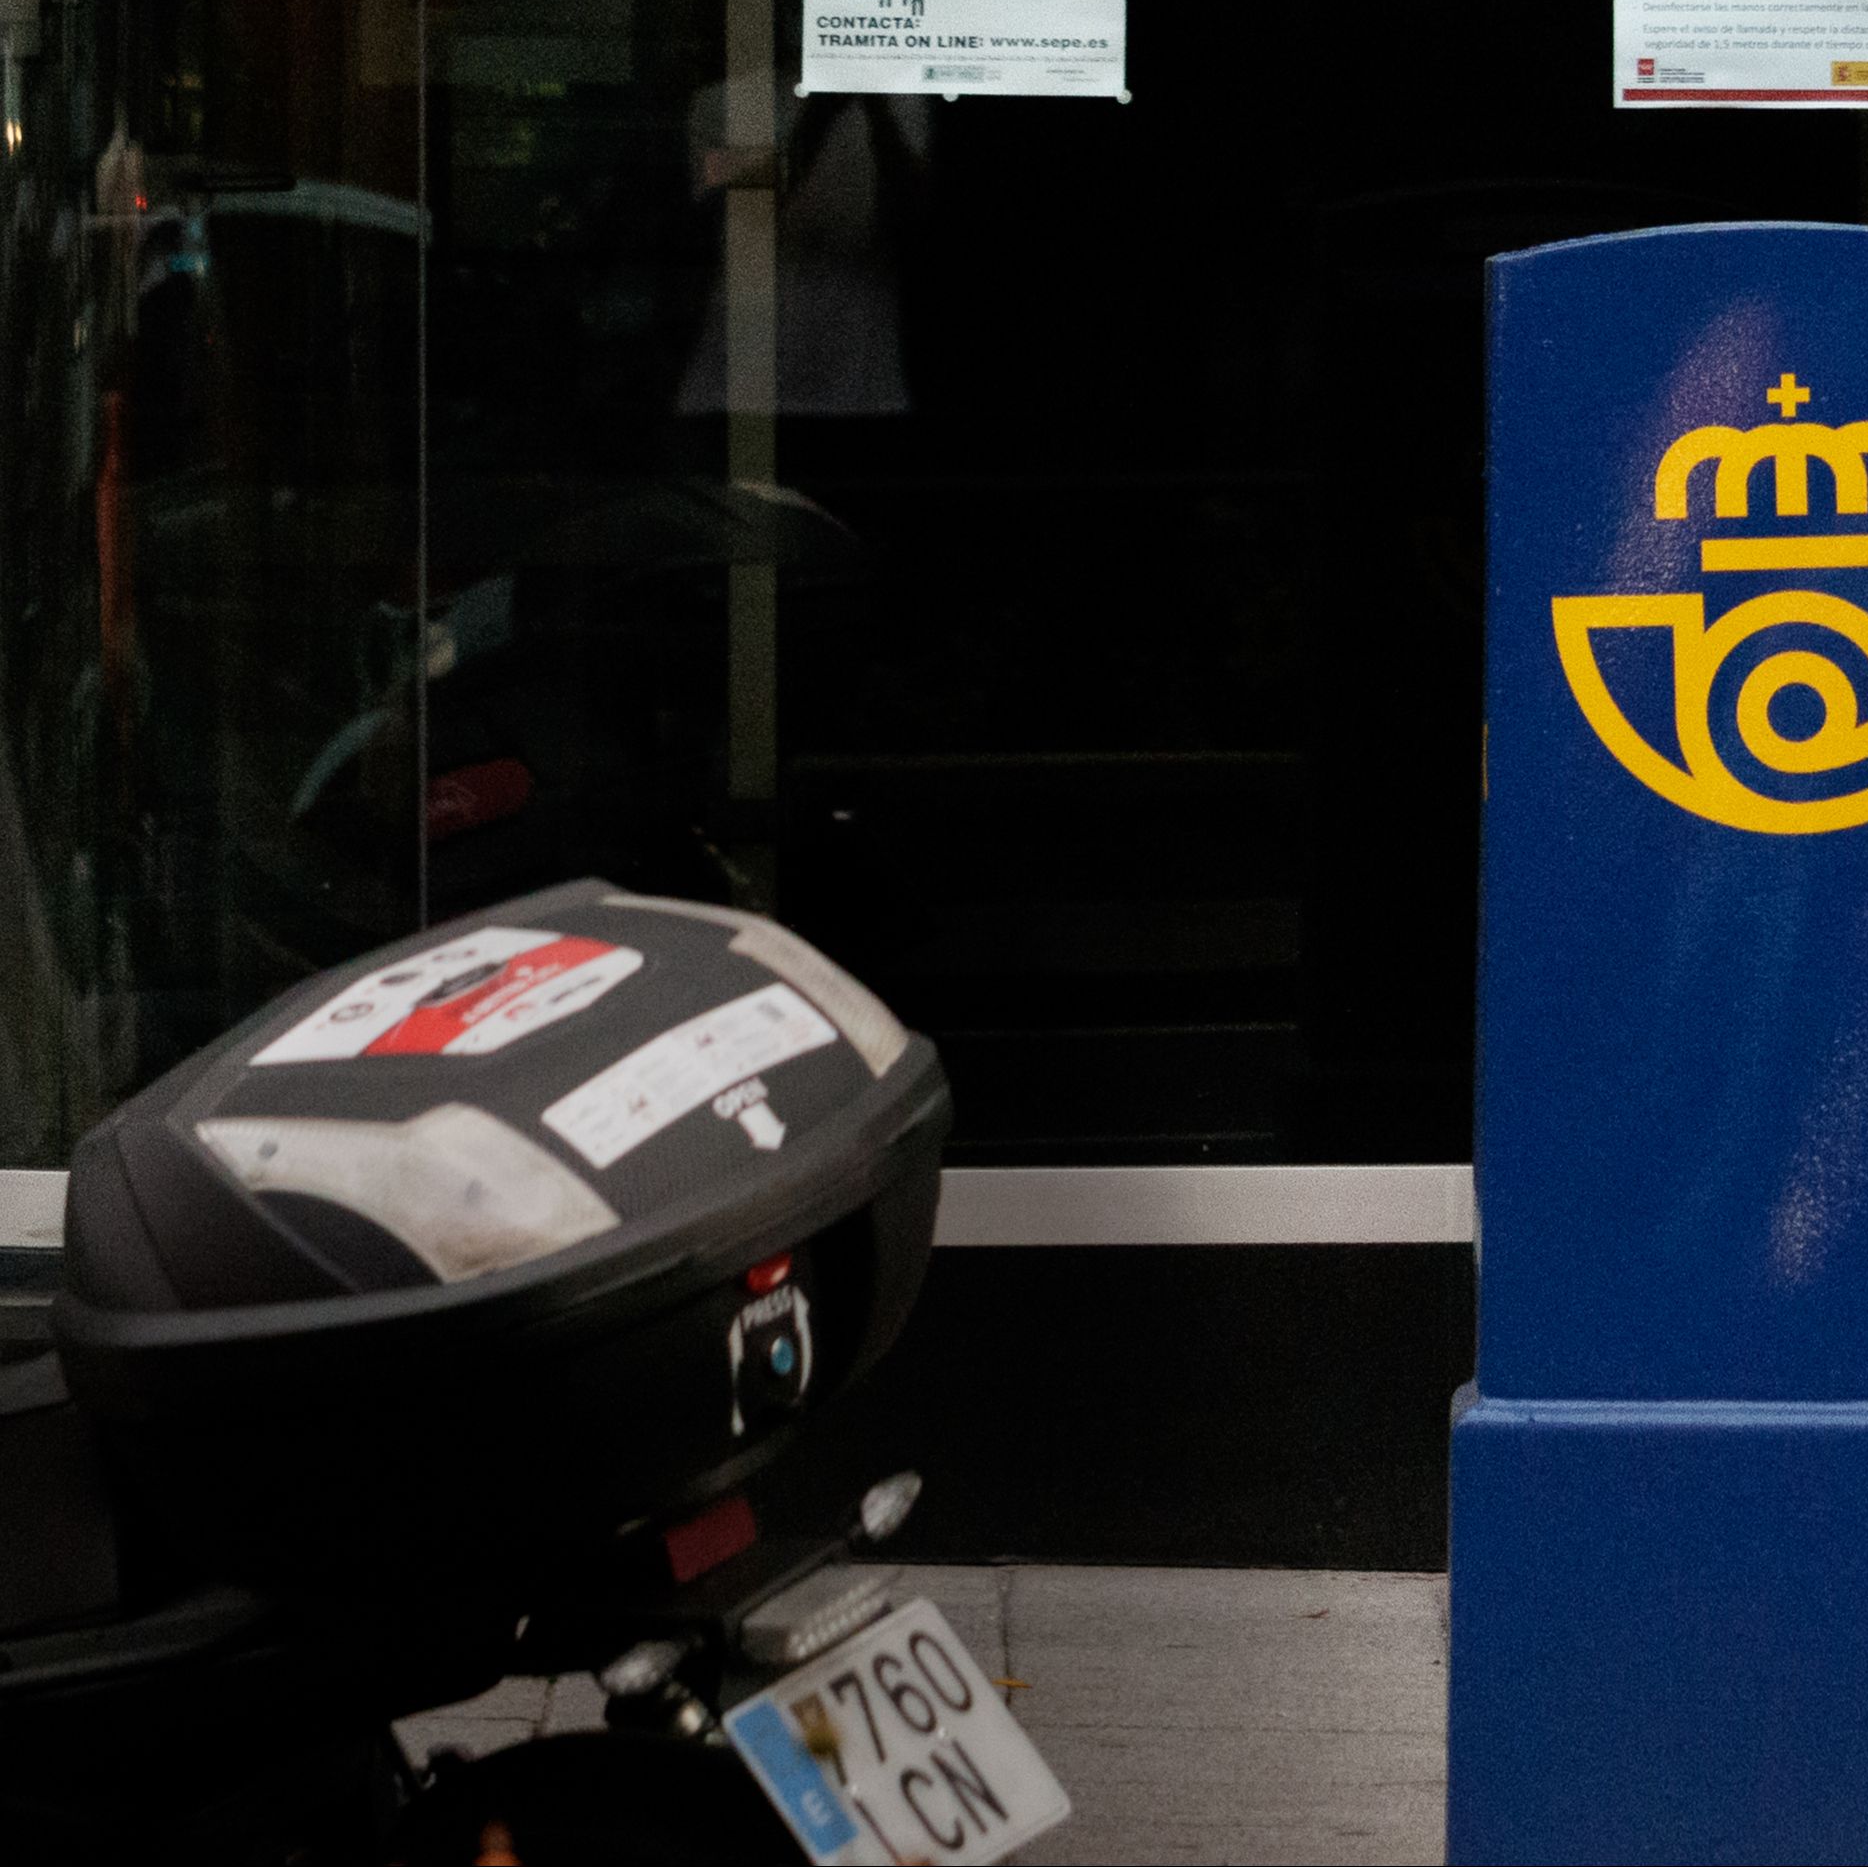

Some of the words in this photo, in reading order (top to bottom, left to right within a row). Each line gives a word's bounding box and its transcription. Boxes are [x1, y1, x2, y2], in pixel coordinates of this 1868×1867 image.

[1730, 4, 1766, 12] manos
[1766, 3, 1844, 12] correctamente
[816, 17, 921, 28] CONTACTA:
[1720, 26, 1734, 34] de
[818, 34, 899, 46] TRAMITA
[904, 35, 931, 47] ON
[937, 36, 983, 48] LINE:
[990, 39, 1108, 48] www.sepe.es
[1697, 41, 1711, 50] de
[1732, 41, 1769, 50] metros
[1771, 41, 1812, 50] durante
[712, 1077, 768, 1120] OPEN
[742, 1286, 792, 1329] PRESS
